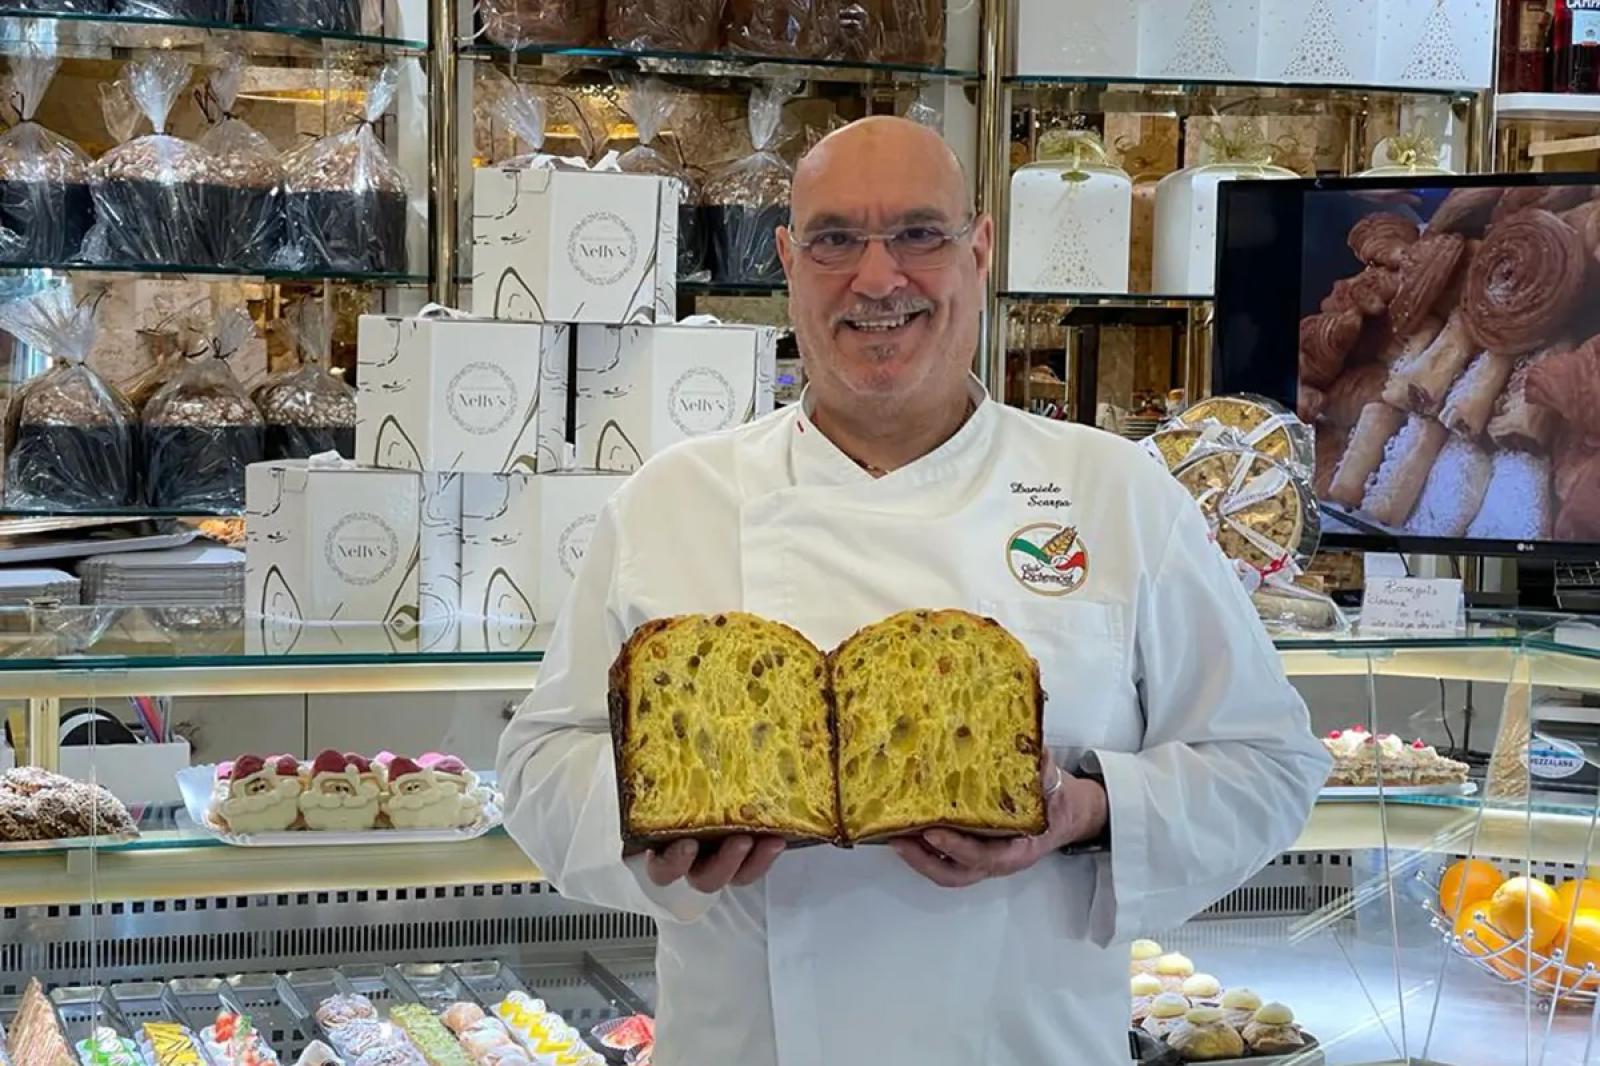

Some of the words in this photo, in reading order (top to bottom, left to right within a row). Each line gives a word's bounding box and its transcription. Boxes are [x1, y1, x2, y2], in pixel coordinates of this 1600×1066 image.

[579, 243, 627, 260] Nelly's
[459, 392, 507, 409] Nelly's
[679, 398, 726, 413] Nelly's
[1010, 482, 1061, 493] Daniele
[1027, 495, 1072, 508] Scarpa
[337, 543, 387, 559] Nelly's
